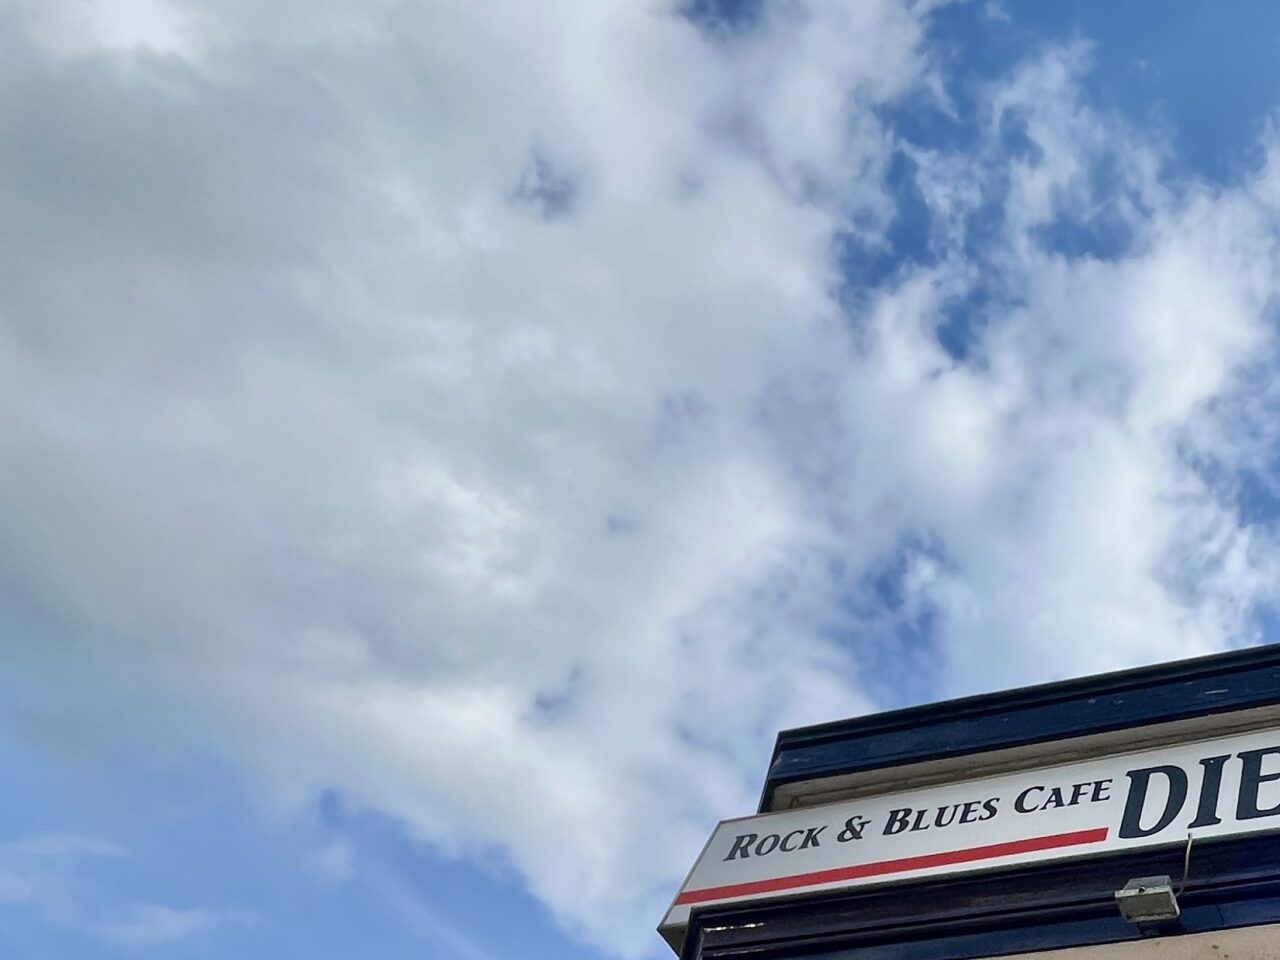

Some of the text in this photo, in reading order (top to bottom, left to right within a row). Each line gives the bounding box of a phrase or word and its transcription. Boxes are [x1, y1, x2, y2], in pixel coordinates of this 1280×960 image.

[723, 823, 829, 862] ROCK
[836, 815, 872, 843] &
[882, 797, 1001, 836] BLUES
[1014, 778, 1114, 814] CAFE
